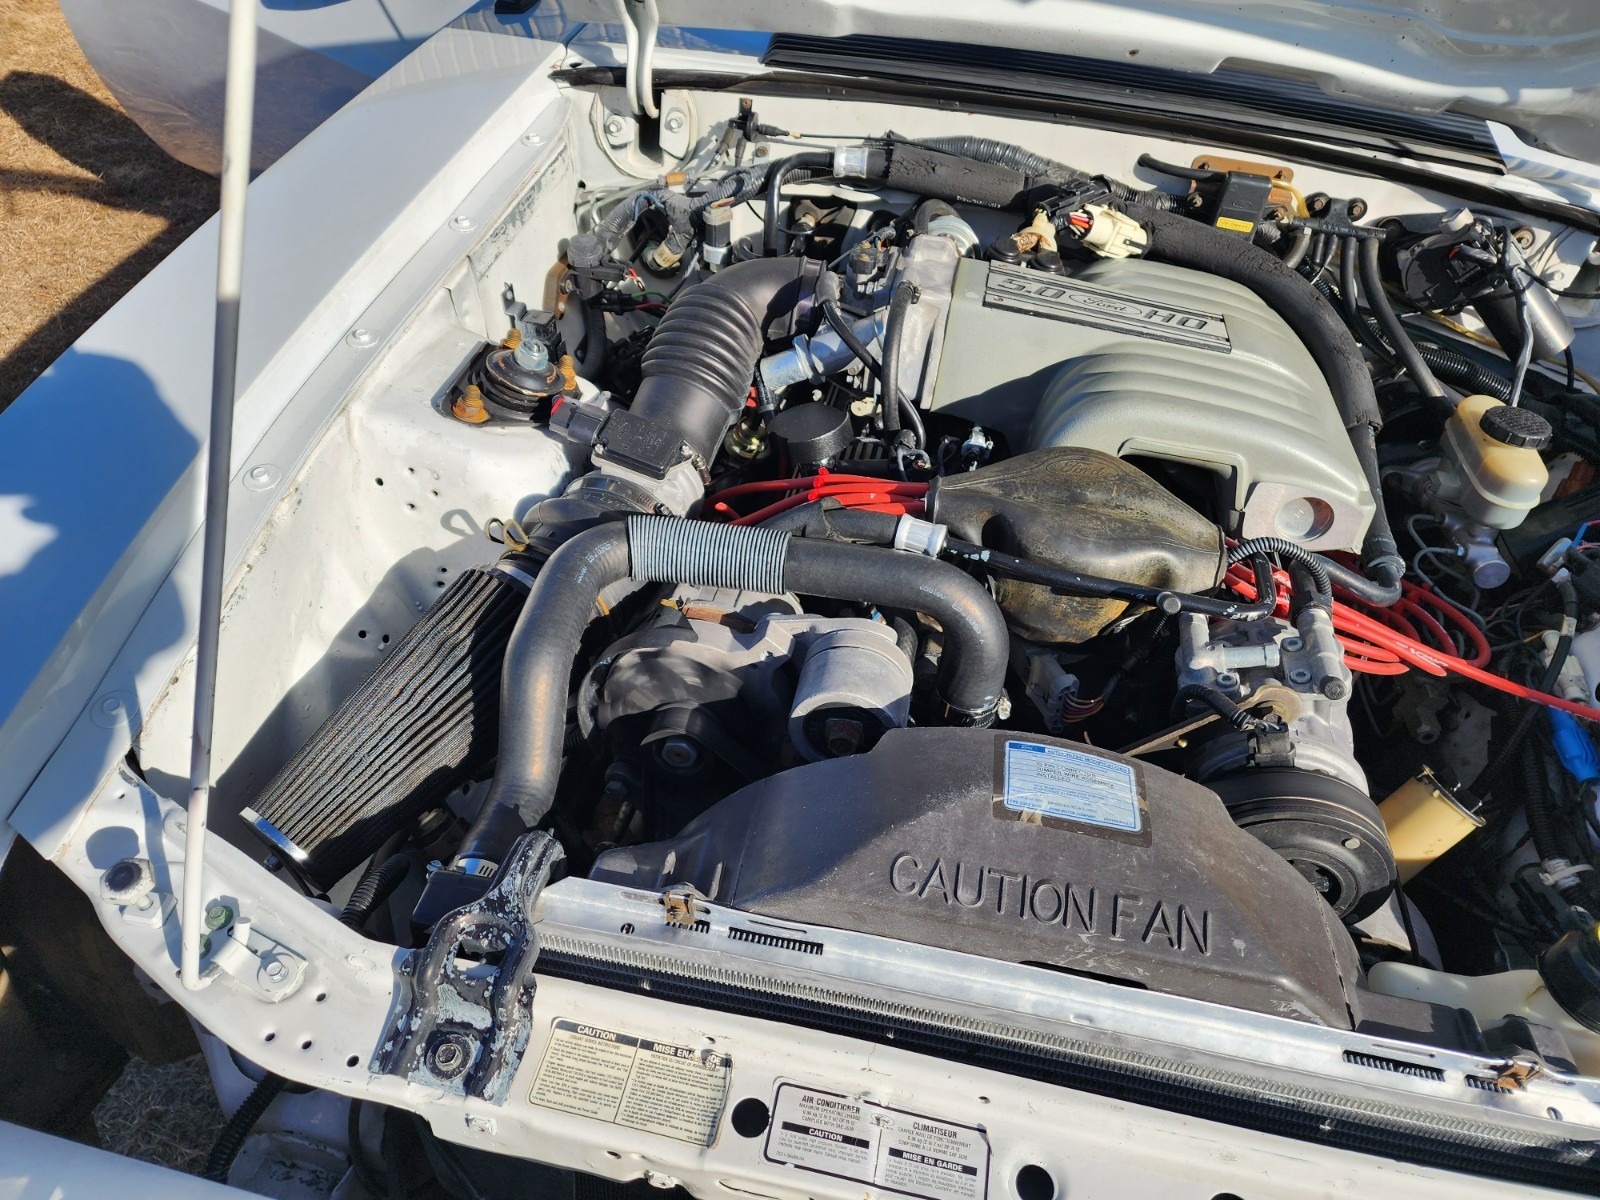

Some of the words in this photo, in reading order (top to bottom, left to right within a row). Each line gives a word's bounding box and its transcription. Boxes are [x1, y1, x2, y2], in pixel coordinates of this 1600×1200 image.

[997, 278, 1067, 299] 5.0
[1083, 296, 1128, 313] Ford
[1143, 309, 1208, 330] HO
[1061, 460, 1105, 476] Ford
[1036, 771, 1070, 782] INSTALLED
[889, 851, 1099, 933] CAUTION
[1111, 893, 1213, 956] FAN
[576, 1025, 617, 1041] CAUTION
[652, 1042, 676, 1055] MISE
[676, 1048, 689, 1058] EN
[801, 1094, 814, 1104] AIR
[816, 1097, 860, 1115] CONDITIONER
[808, 1127, 842, 1142] CAUTION
[912, 1121, 957, 1139] CLIMATISEUR
[902, 1151, 922, 1162] MISE
[923, 1156, 934, 1165] EN
[936, 1159, 962, 1172] GARDE
